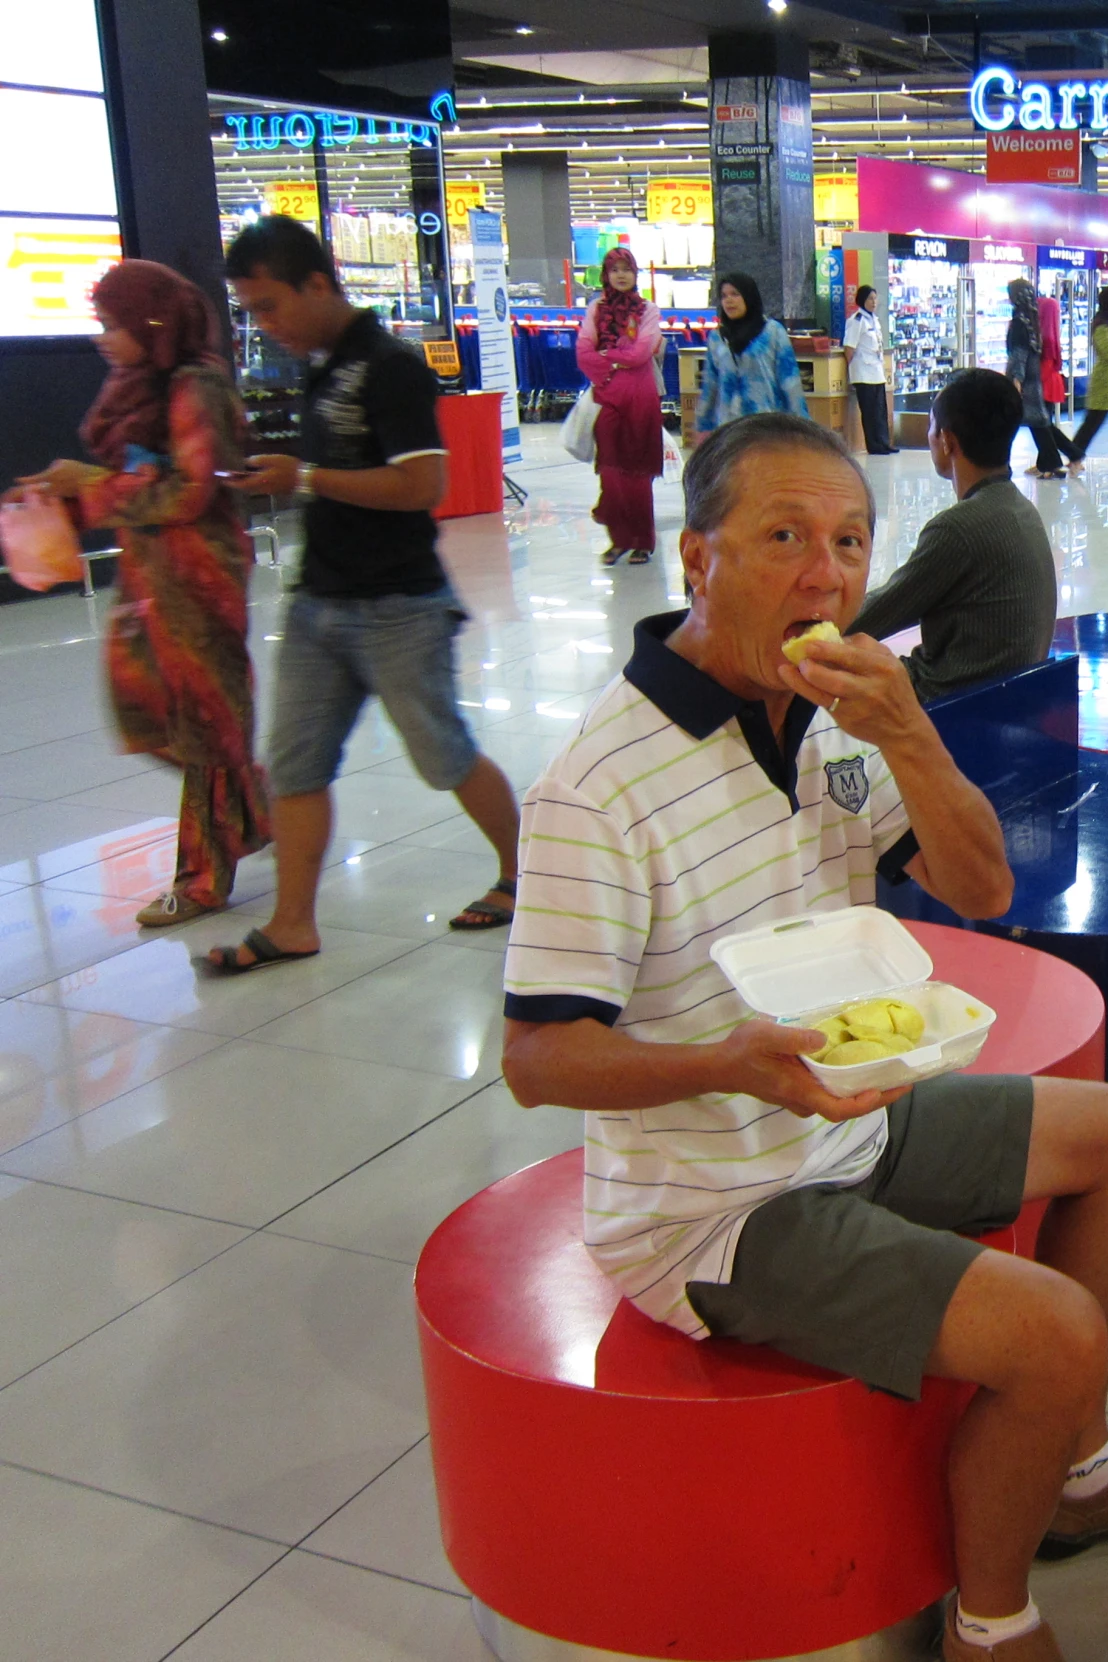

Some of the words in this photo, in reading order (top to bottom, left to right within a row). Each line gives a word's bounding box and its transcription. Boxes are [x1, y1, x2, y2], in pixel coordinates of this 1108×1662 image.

[717, 145, 734, 155] Eco
[736, 144, 771, 154] Counter
[991, 136, 1074, 152] Welcome
[722, 167, 755, 179] Reuse
[914, 239, 947, 257] REVLON
[839, 771, 858, 793] M
